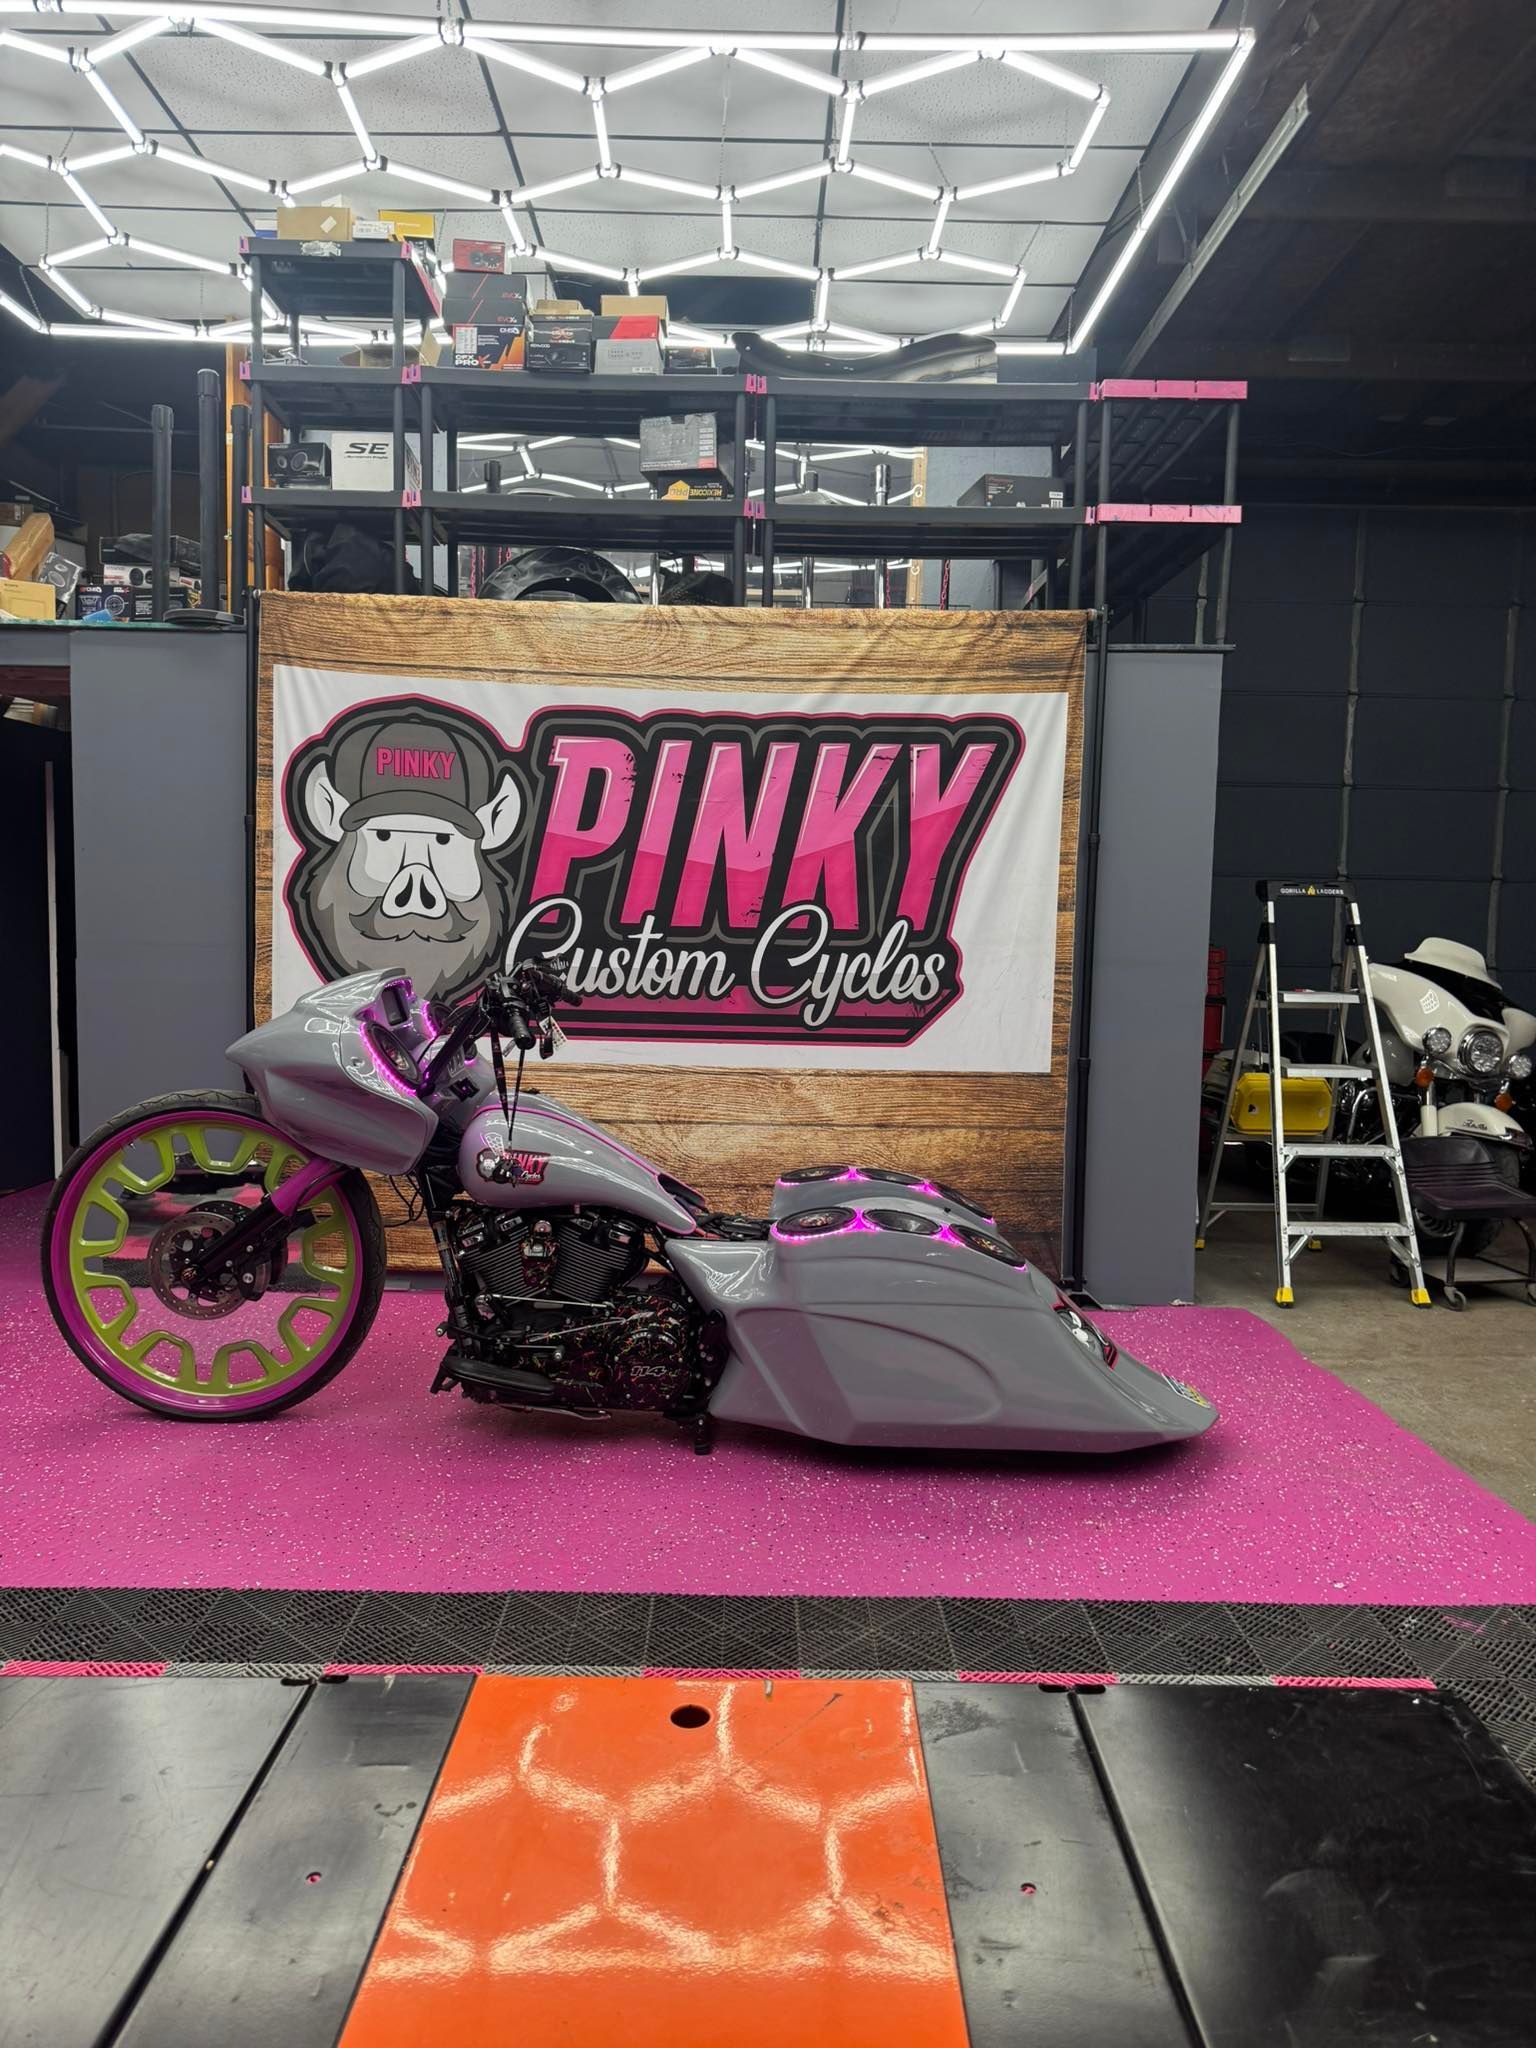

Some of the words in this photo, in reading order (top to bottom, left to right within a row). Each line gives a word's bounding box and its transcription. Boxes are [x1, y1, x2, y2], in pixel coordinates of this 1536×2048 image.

[344, 442, 389, 454] SE
[376, 747, 457, 780] PINKY
[529, 735, 998, 932] PINKY
[505, 897, 736, 998] Custom
[750, 903, 945, 1027] Cycles
[630, 1366, 668, 1377] 114
